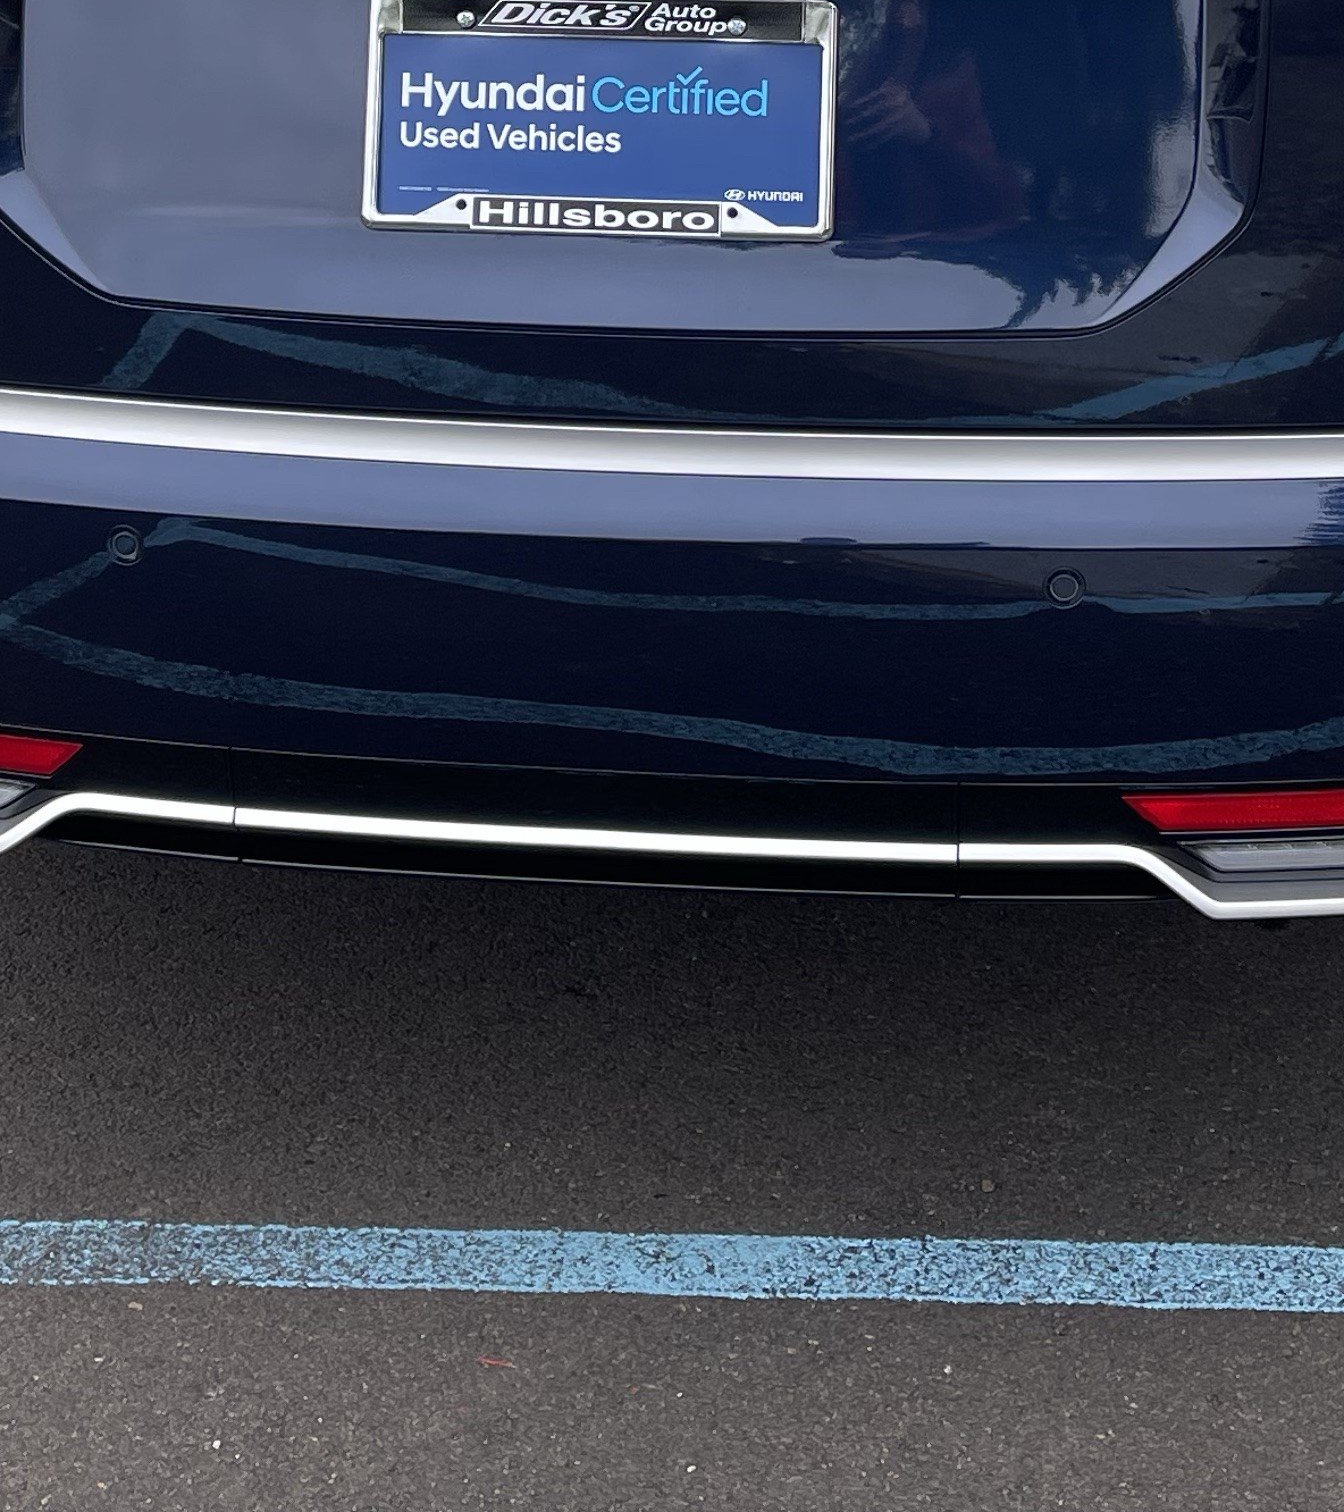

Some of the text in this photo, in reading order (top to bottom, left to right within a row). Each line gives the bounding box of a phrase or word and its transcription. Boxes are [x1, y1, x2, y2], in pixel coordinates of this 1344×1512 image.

[491, 2, 717, 27] Dick's Auto
[644, 17, 728, 36] Group
[401, 66, 769, 117] Hyundai Certified
[400, 121, 622, 153] Used Vehicles
[747, 190, 804, 202] HYUNDAI
[479, 200, 715, 230] Hillsboro
